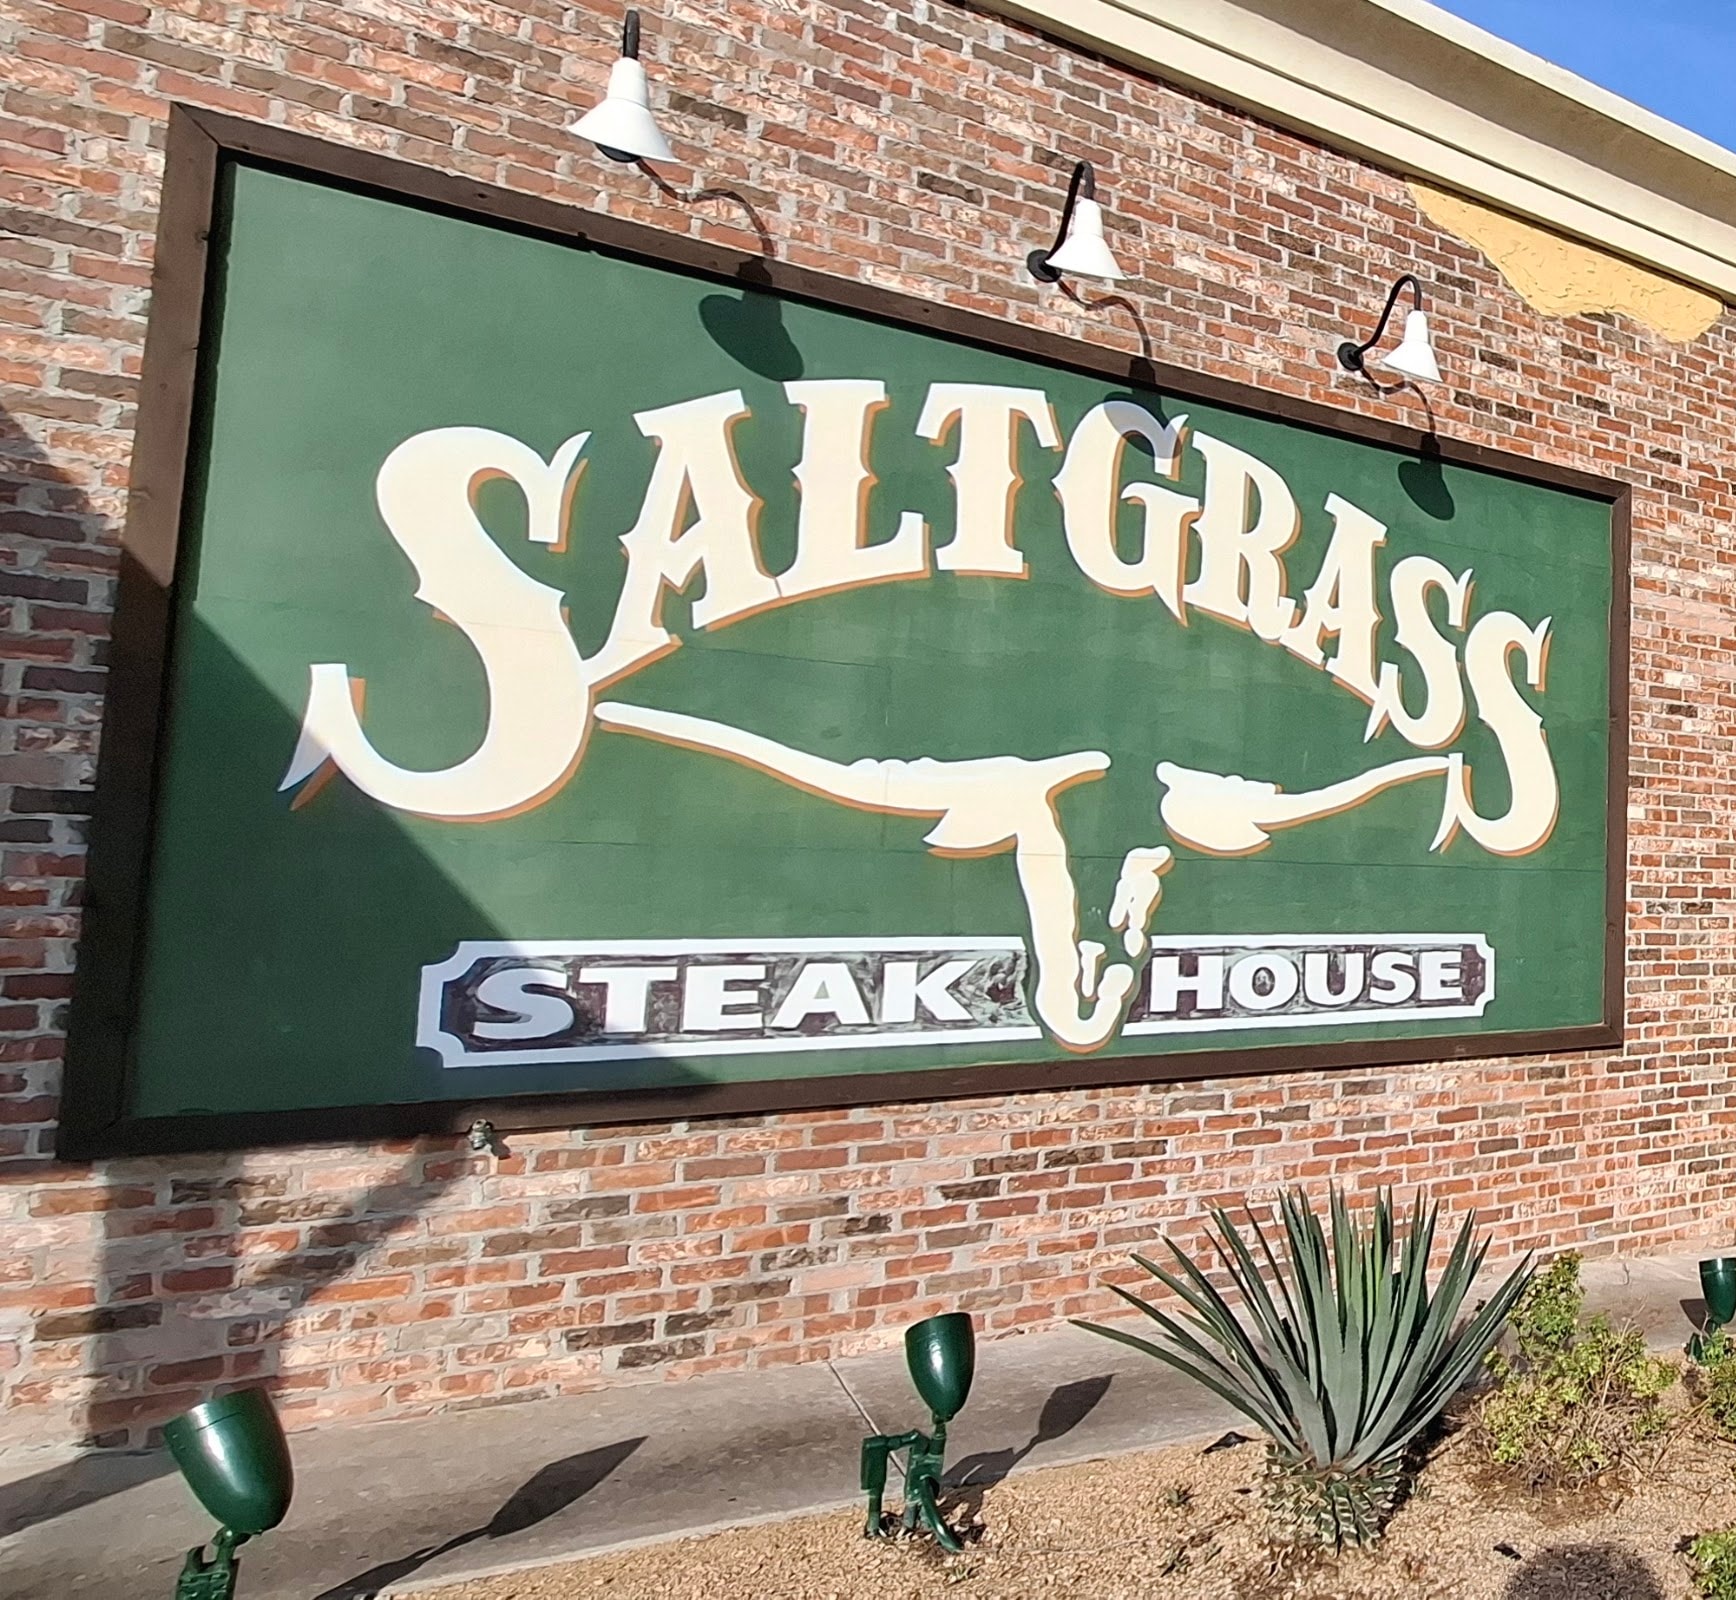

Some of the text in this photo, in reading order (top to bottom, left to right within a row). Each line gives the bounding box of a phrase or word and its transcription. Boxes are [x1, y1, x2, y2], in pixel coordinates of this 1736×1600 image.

[279, 380, 1558, 854] SALTGRASS
[472, 950, 1463, 1040] STEAK HOUSE
